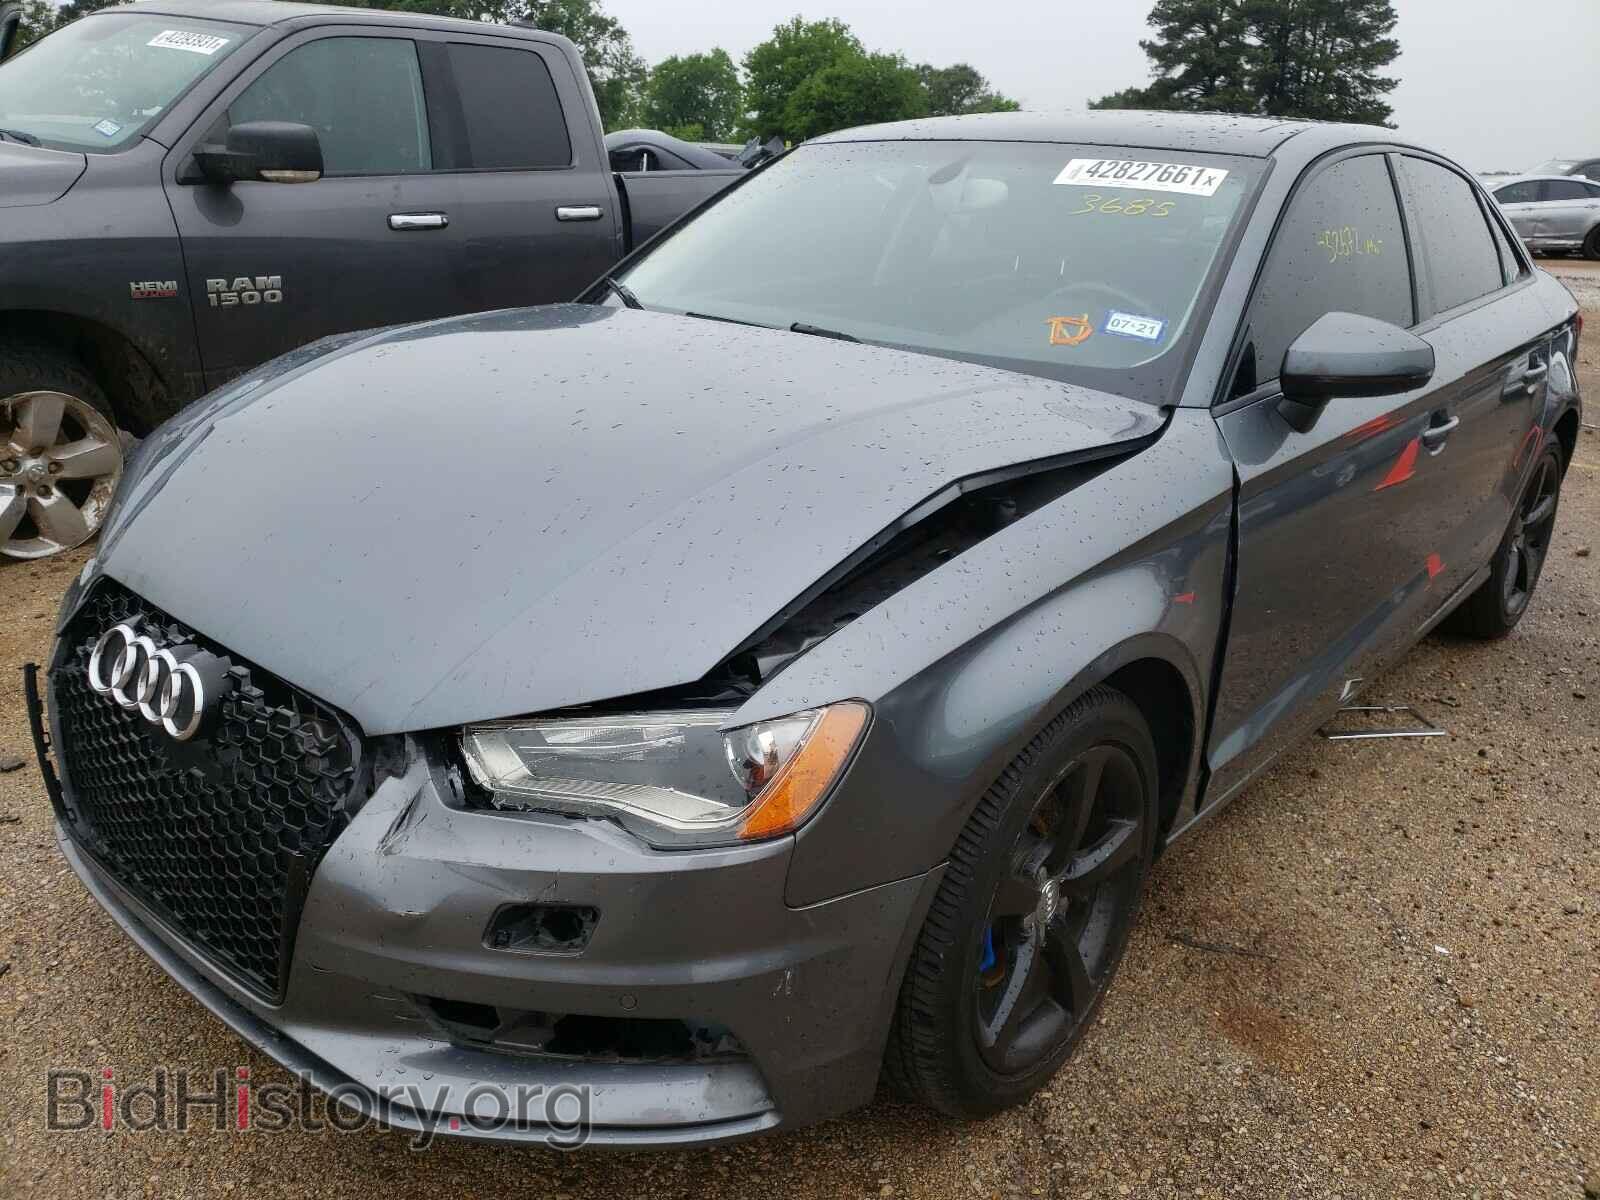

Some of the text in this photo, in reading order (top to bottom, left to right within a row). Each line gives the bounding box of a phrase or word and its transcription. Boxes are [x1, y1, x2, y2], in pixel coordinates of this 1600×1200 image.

[130, 280, 177, 291] HEMI
[206, 275, 281, 291] RAM
[207, 290, 283, 307] 1500
